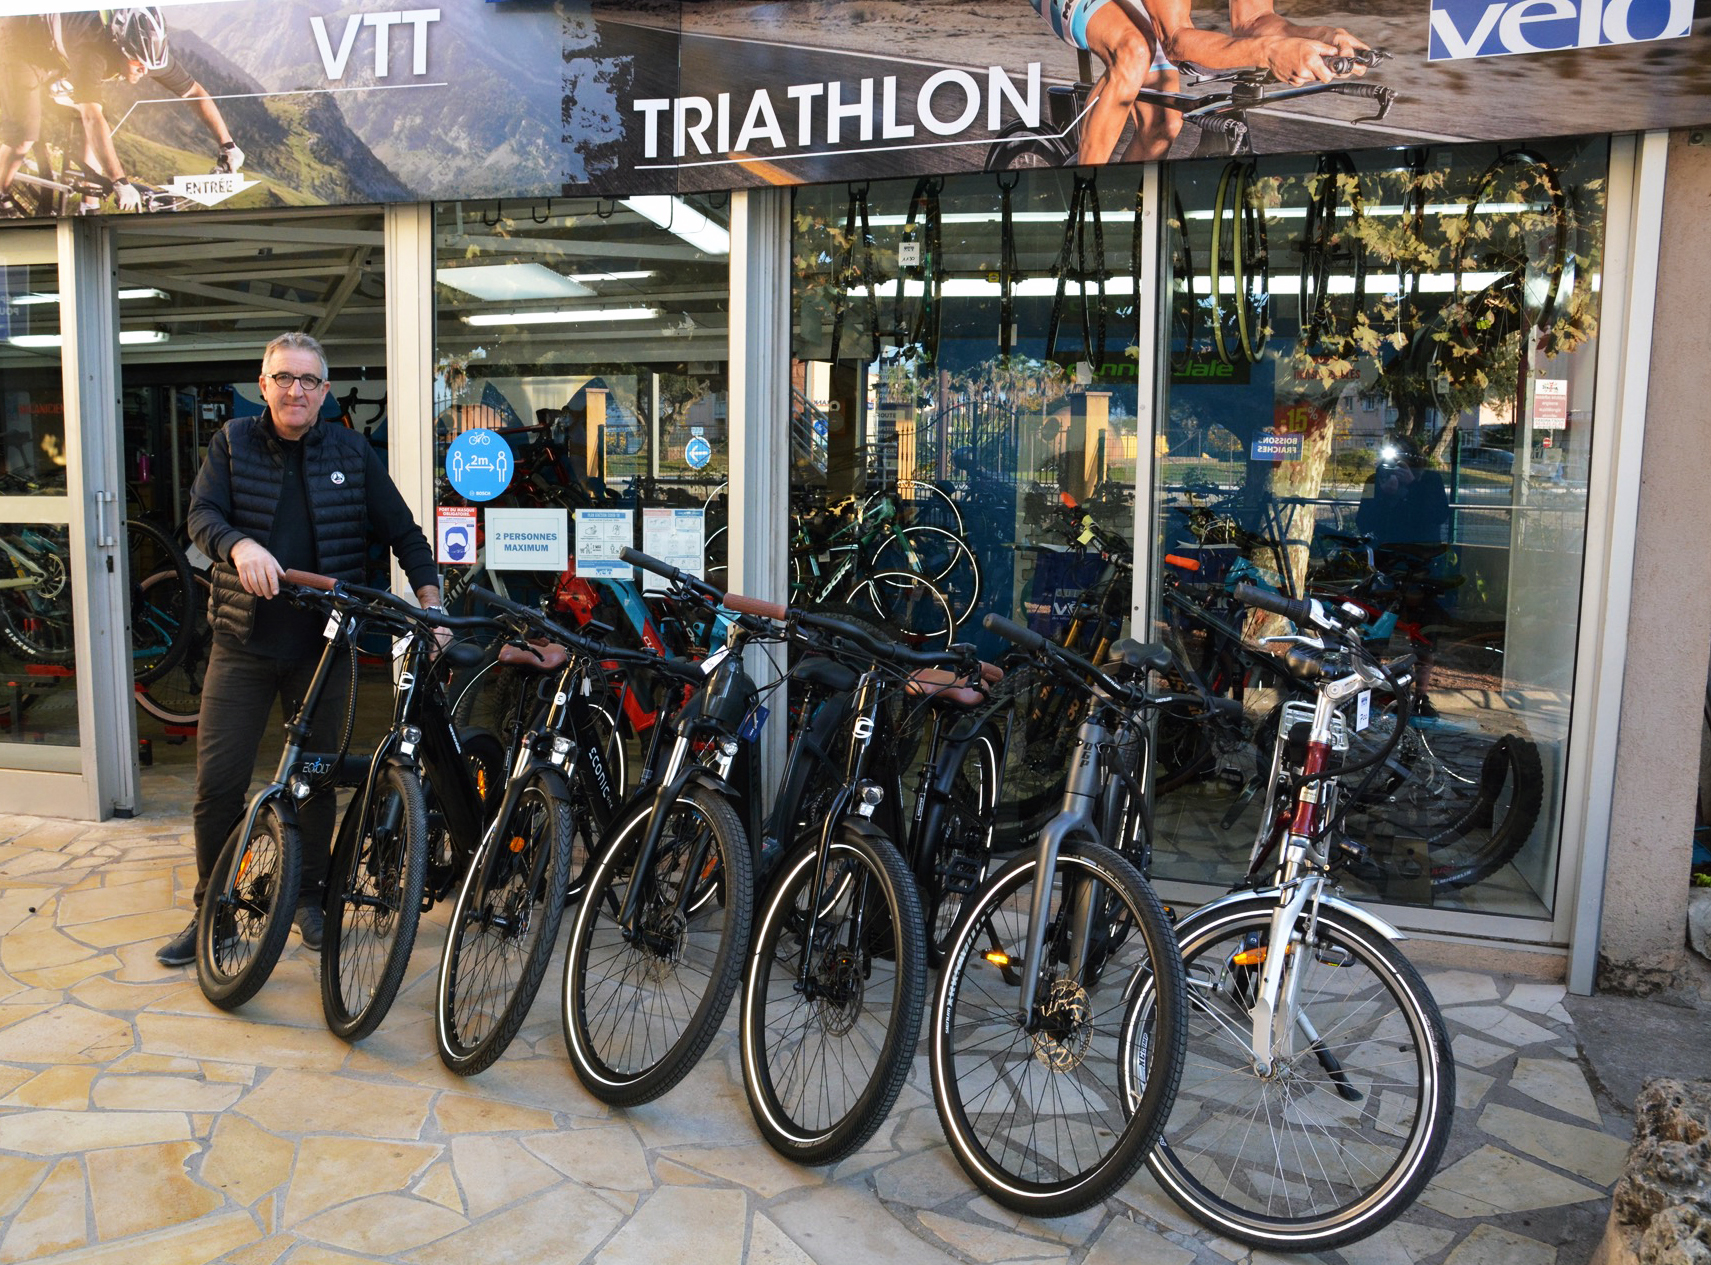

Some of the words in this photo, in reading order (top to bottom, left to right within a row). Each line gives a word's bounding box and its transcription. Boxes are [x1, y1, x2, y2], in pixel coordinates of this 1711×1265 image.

[309, 8, 441, 80] VTT
[633, 62, 1041, 158] TRIATHLON
[185, 178, 234, 195] ENTRÉE
[471, 455, 489, 465] 2m
[503, 532, 557, 541] PERSONNES
[504, 544, 549, 552] MAXIMUM
[815, 559, 852, 603] LOOK
[4, 628, 36, 655] MAXXIS
